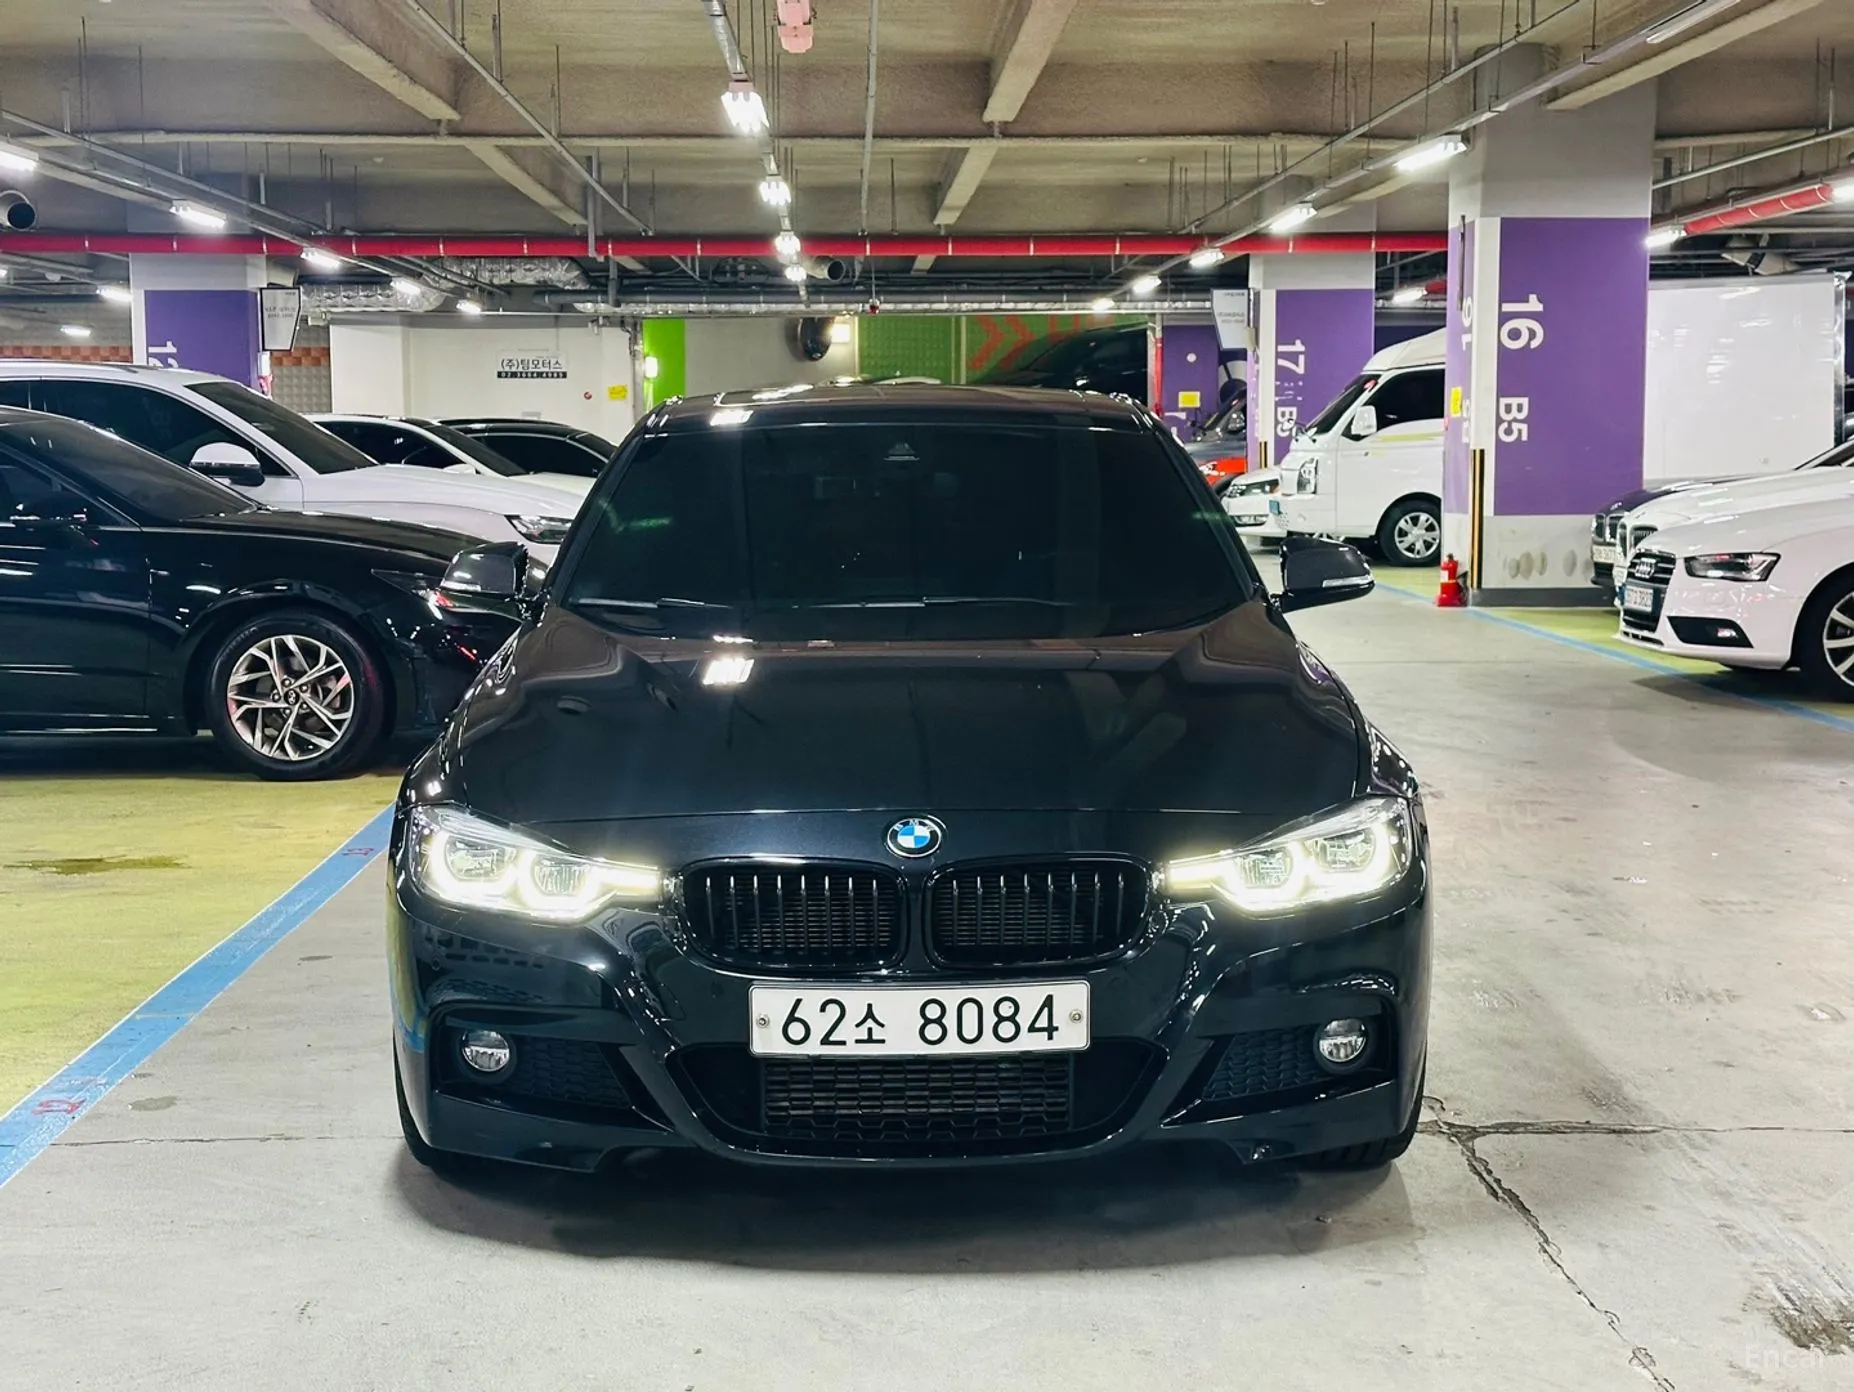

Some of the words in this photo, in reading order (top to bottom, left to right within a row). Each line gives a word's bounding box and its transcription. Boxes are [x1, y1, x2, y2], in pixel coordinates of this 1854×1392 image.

[1499, 293, 1545, 350] 16
[1277, 339, 1306, 374] 17
[1498, 396, 1530, 443] B5
[781, 997, 886, 1047] 62소
[918, 994, 1060, 1046] 8084
